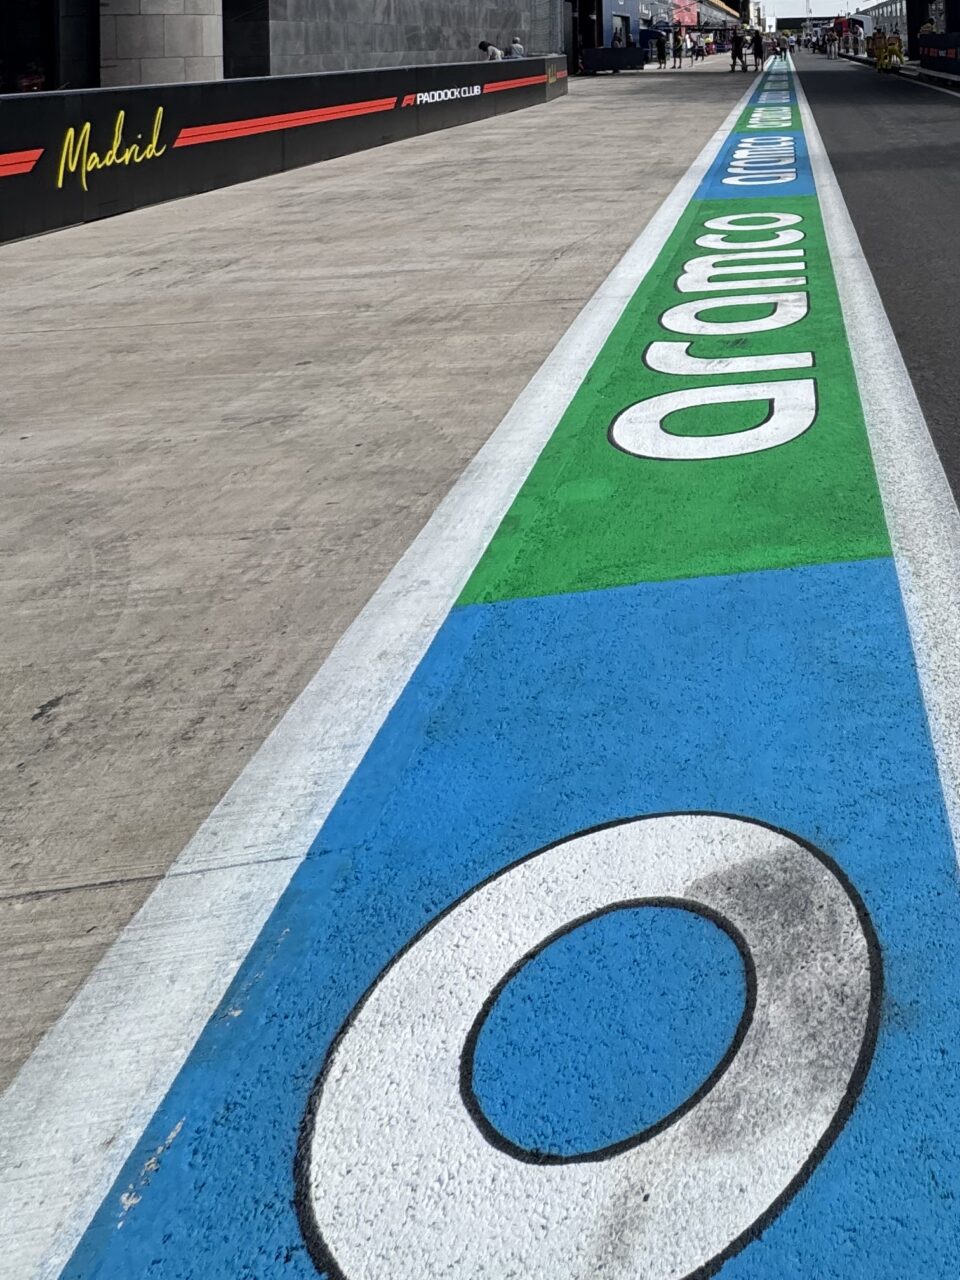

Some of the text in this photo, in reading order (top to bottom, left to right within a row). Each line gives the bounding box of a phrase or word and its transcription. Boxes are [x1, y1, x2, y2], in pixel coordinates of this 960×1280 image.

[416, 88, 460, 105] PADDOCK
[461, 85, 482, 98] CLUB
[57, 106, 167, 191] Madrid
[720, 135, 798, 186] aramco
[607, 212, 819, 461] aramco
